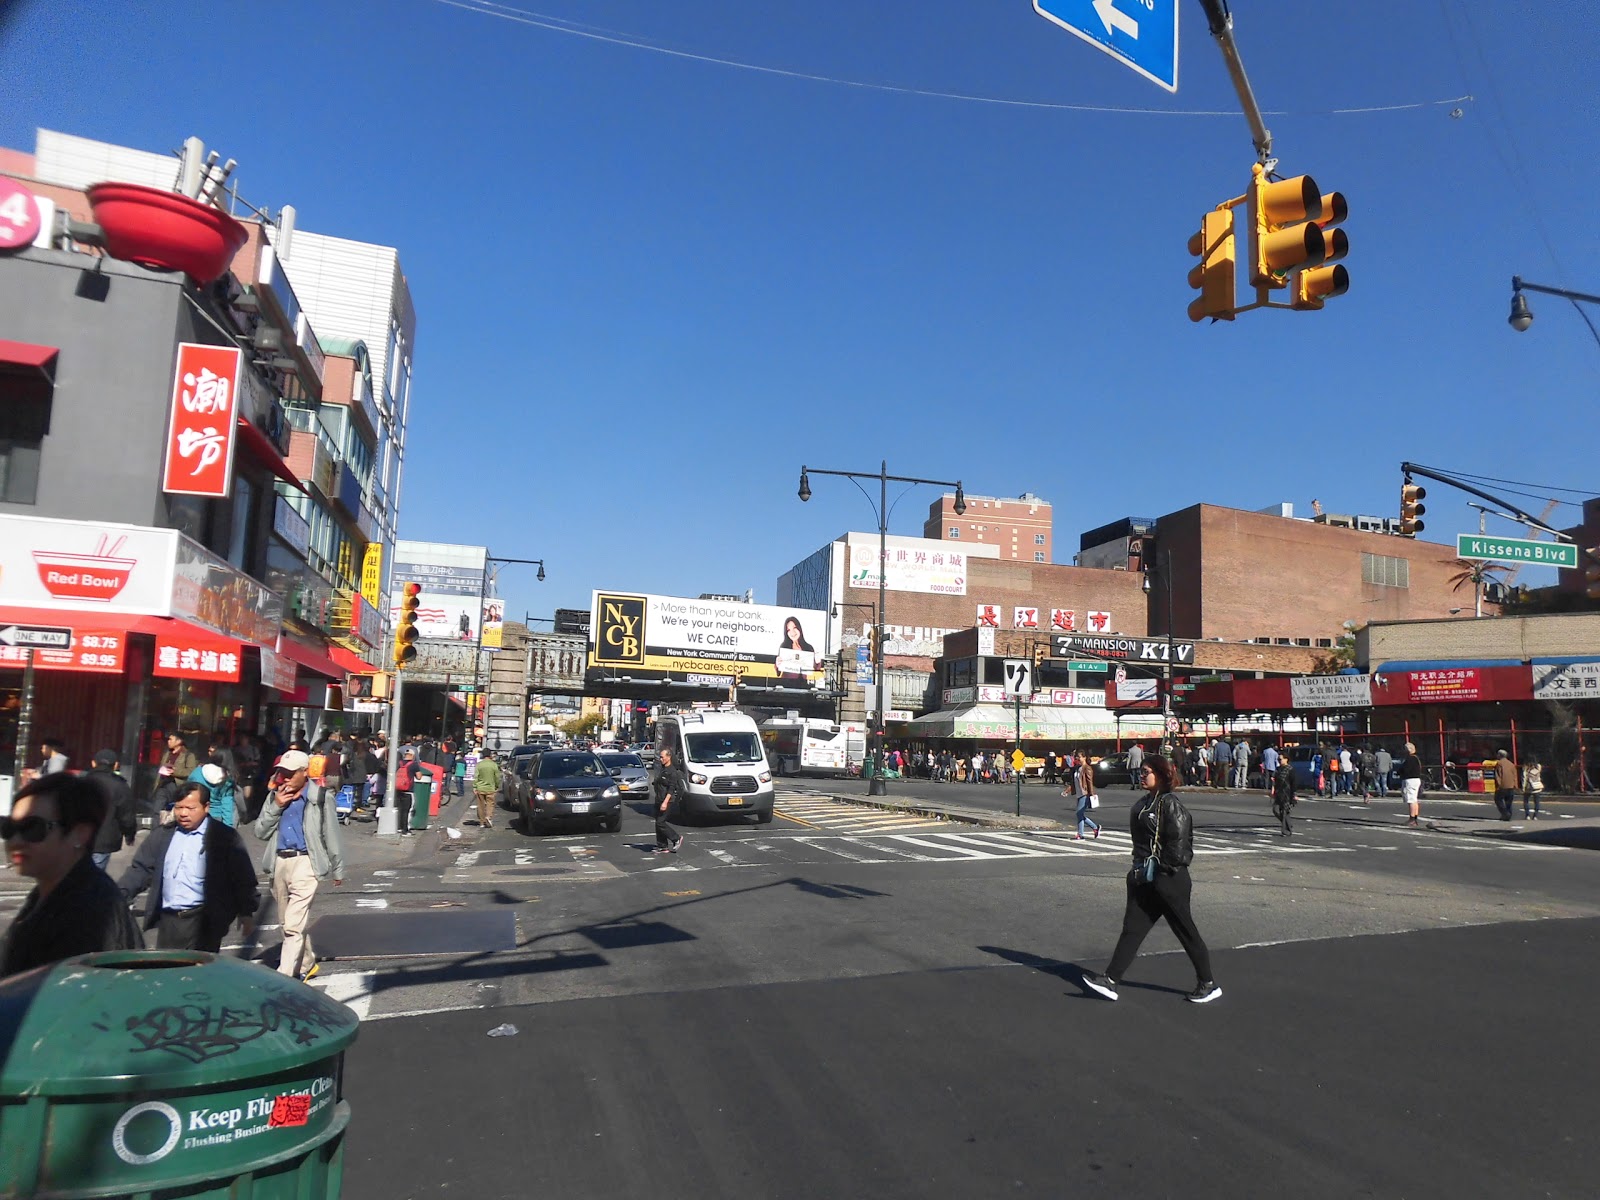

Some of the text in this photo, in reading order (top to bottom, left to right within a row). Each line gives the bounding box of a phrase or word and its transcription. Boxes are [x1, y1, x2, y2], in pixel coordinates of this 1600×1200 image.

[177, 367, 229, 476] 潮坊
[1472, 541, 1566, 561] Kissena Blvd
[47, 571, 119, 588] Red Bowl
[930, 584, 962, 593] FOOD COURT
[660, 602, 686, 613] More
[690, 604, 711, 616] than
[715, 609, 735, 619] your
[662, 615, 689, 627] We're
[692, 619, 713, 629] your
[978, 606, 1109, 631] 長江超市
[13, 632, 63, 643] ONE WAY
[82, 636, 118, 649] $8.75
[688, 633, 738, 647] WE CARE!
[682, 650, 698, 658] York
[699, 651, 737, 661] Community
[739, 653, 755, 661] Bank
[1083, 638, 1137, 651] MANSION
[1140, 642, 1192, 661] KTV
[81, 653, 117, 666] $9.95
[672, 661, 749, 674] nycbcares.com
[1322, 675, 1366, 685] EYEWEAR
[1077, 693, 1095, 705] Food
[188, 1107, 241, 1131] Keep
[184, 1133, 232, 1150] Flushing
